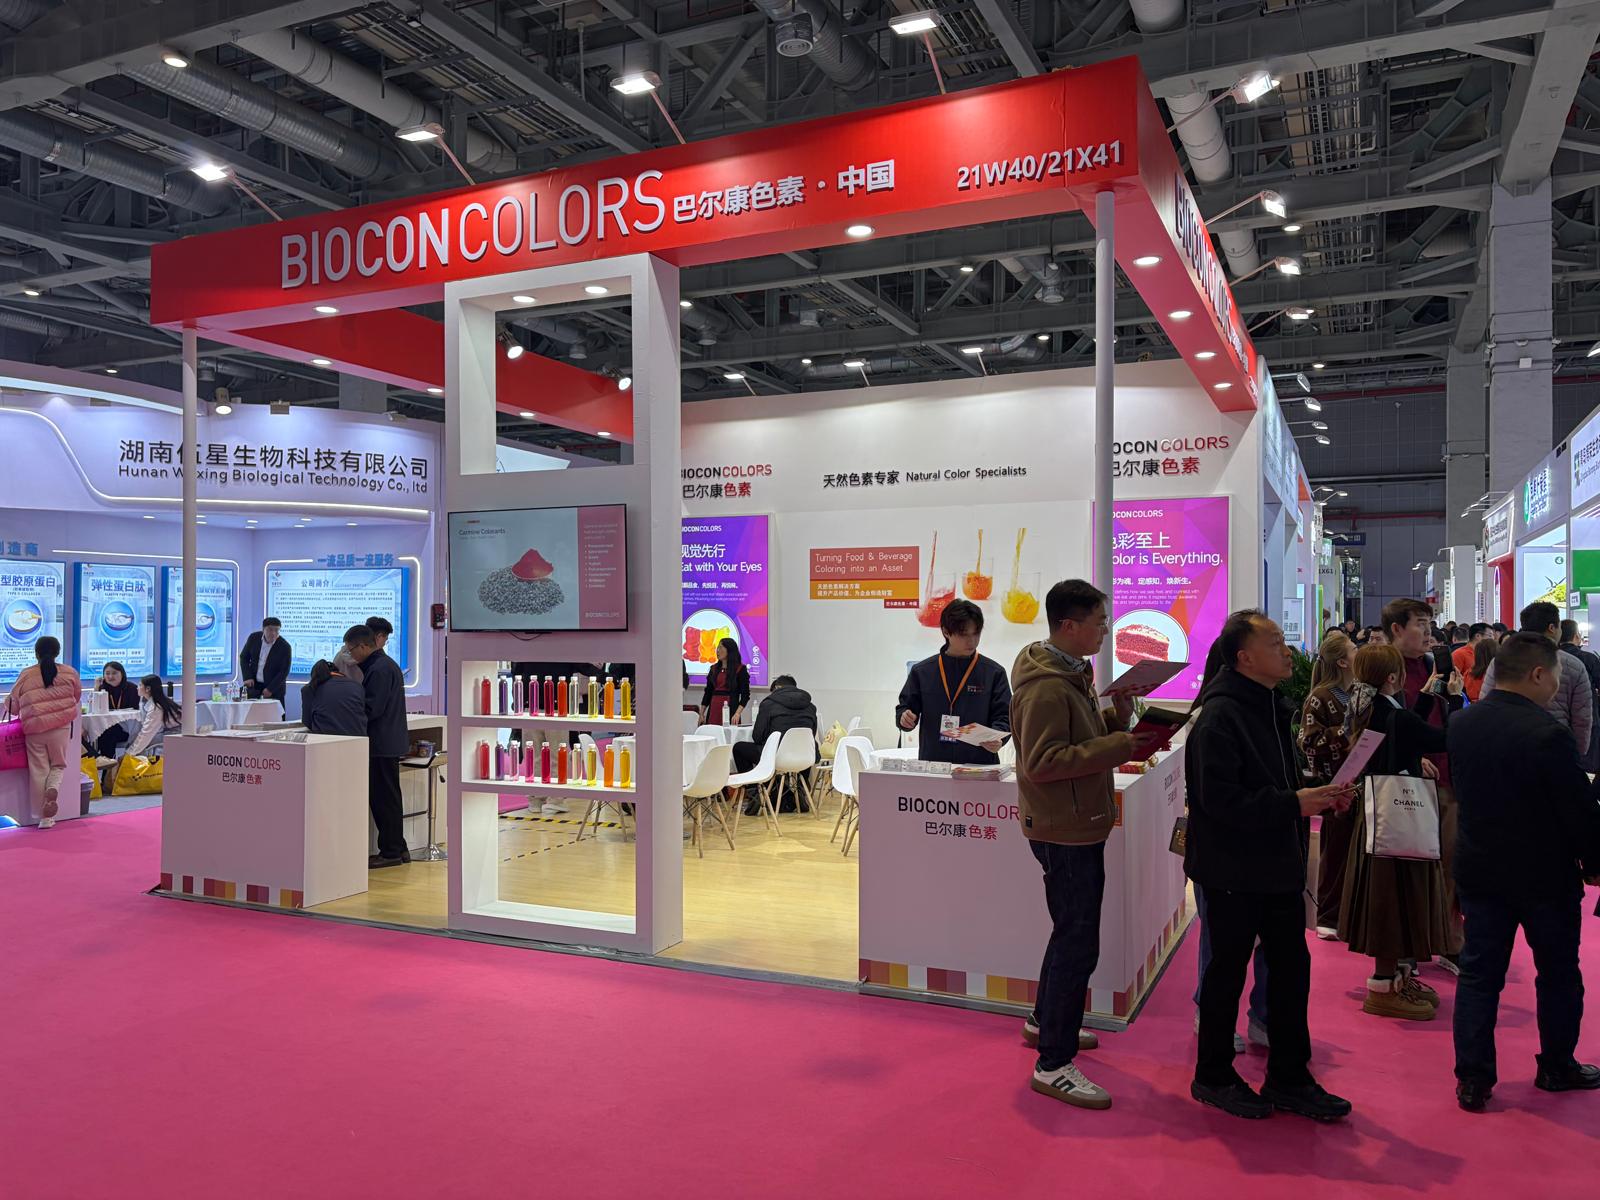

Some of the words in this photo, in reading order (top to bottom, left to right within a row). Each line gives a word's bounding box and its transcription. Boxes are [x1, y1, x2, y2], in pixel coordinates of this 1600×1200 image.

[281, 208, 448, 289] BIOCON
[459, 169, 665, 262] COLORS
[957, 140, 1121, 190] 21W40/21X41
[1112, 439, 1157, 455] OCON
[1160, 436, 1230, 453] COLORS
[119, 465, 168, 479] Hunan
[172, 466, 228, 484] Wxing
[232, 469, 304, 488] Biological
[308, 473, 385, 493] Technology
[681, 466, 721, 479] IOCON
[722, 464, 773, 479] COLORS
[823, 470, 900, 489] 天然色素专家
[906, 470, 941, 482] Natural
[944, 469, 971, 480] Color
[975, 466, 1027, 479] Specialists
[682, 482, 752, 499] 巴尔康色素
[846, 552, 865, 561] Food
[868, 552, 875, 561] &
[878, 552, 913, 562] Beverage
[1113, 553, 1136, 565] olor
[1139, 553, 1149, 565] is
[1152, 551, 1224, 567] Everything.
[694, 562, 715, 572] with
[716, 562, 738, 572] Your
[740, 562, 762, 574] Eyes
[815, 564, 846, 574] Coloring
[850, 564, 865, 573] into
[881, 563, 903, 572] Asset
[91, 578, 146, 593] 弹性蛋白肽
[207, 754, 242, 768] BIOCON
[244, 756, 282, 771] COLORS
[222, 771, 263, 785] 巴尔康色素
[898, 796, 960, 815] BIOCON
[963, 801, 1020, 821] COLOR
[1393, 798, 1425, 808] CHANEL
[925, 821, 998, 840] 巴尔康色素
